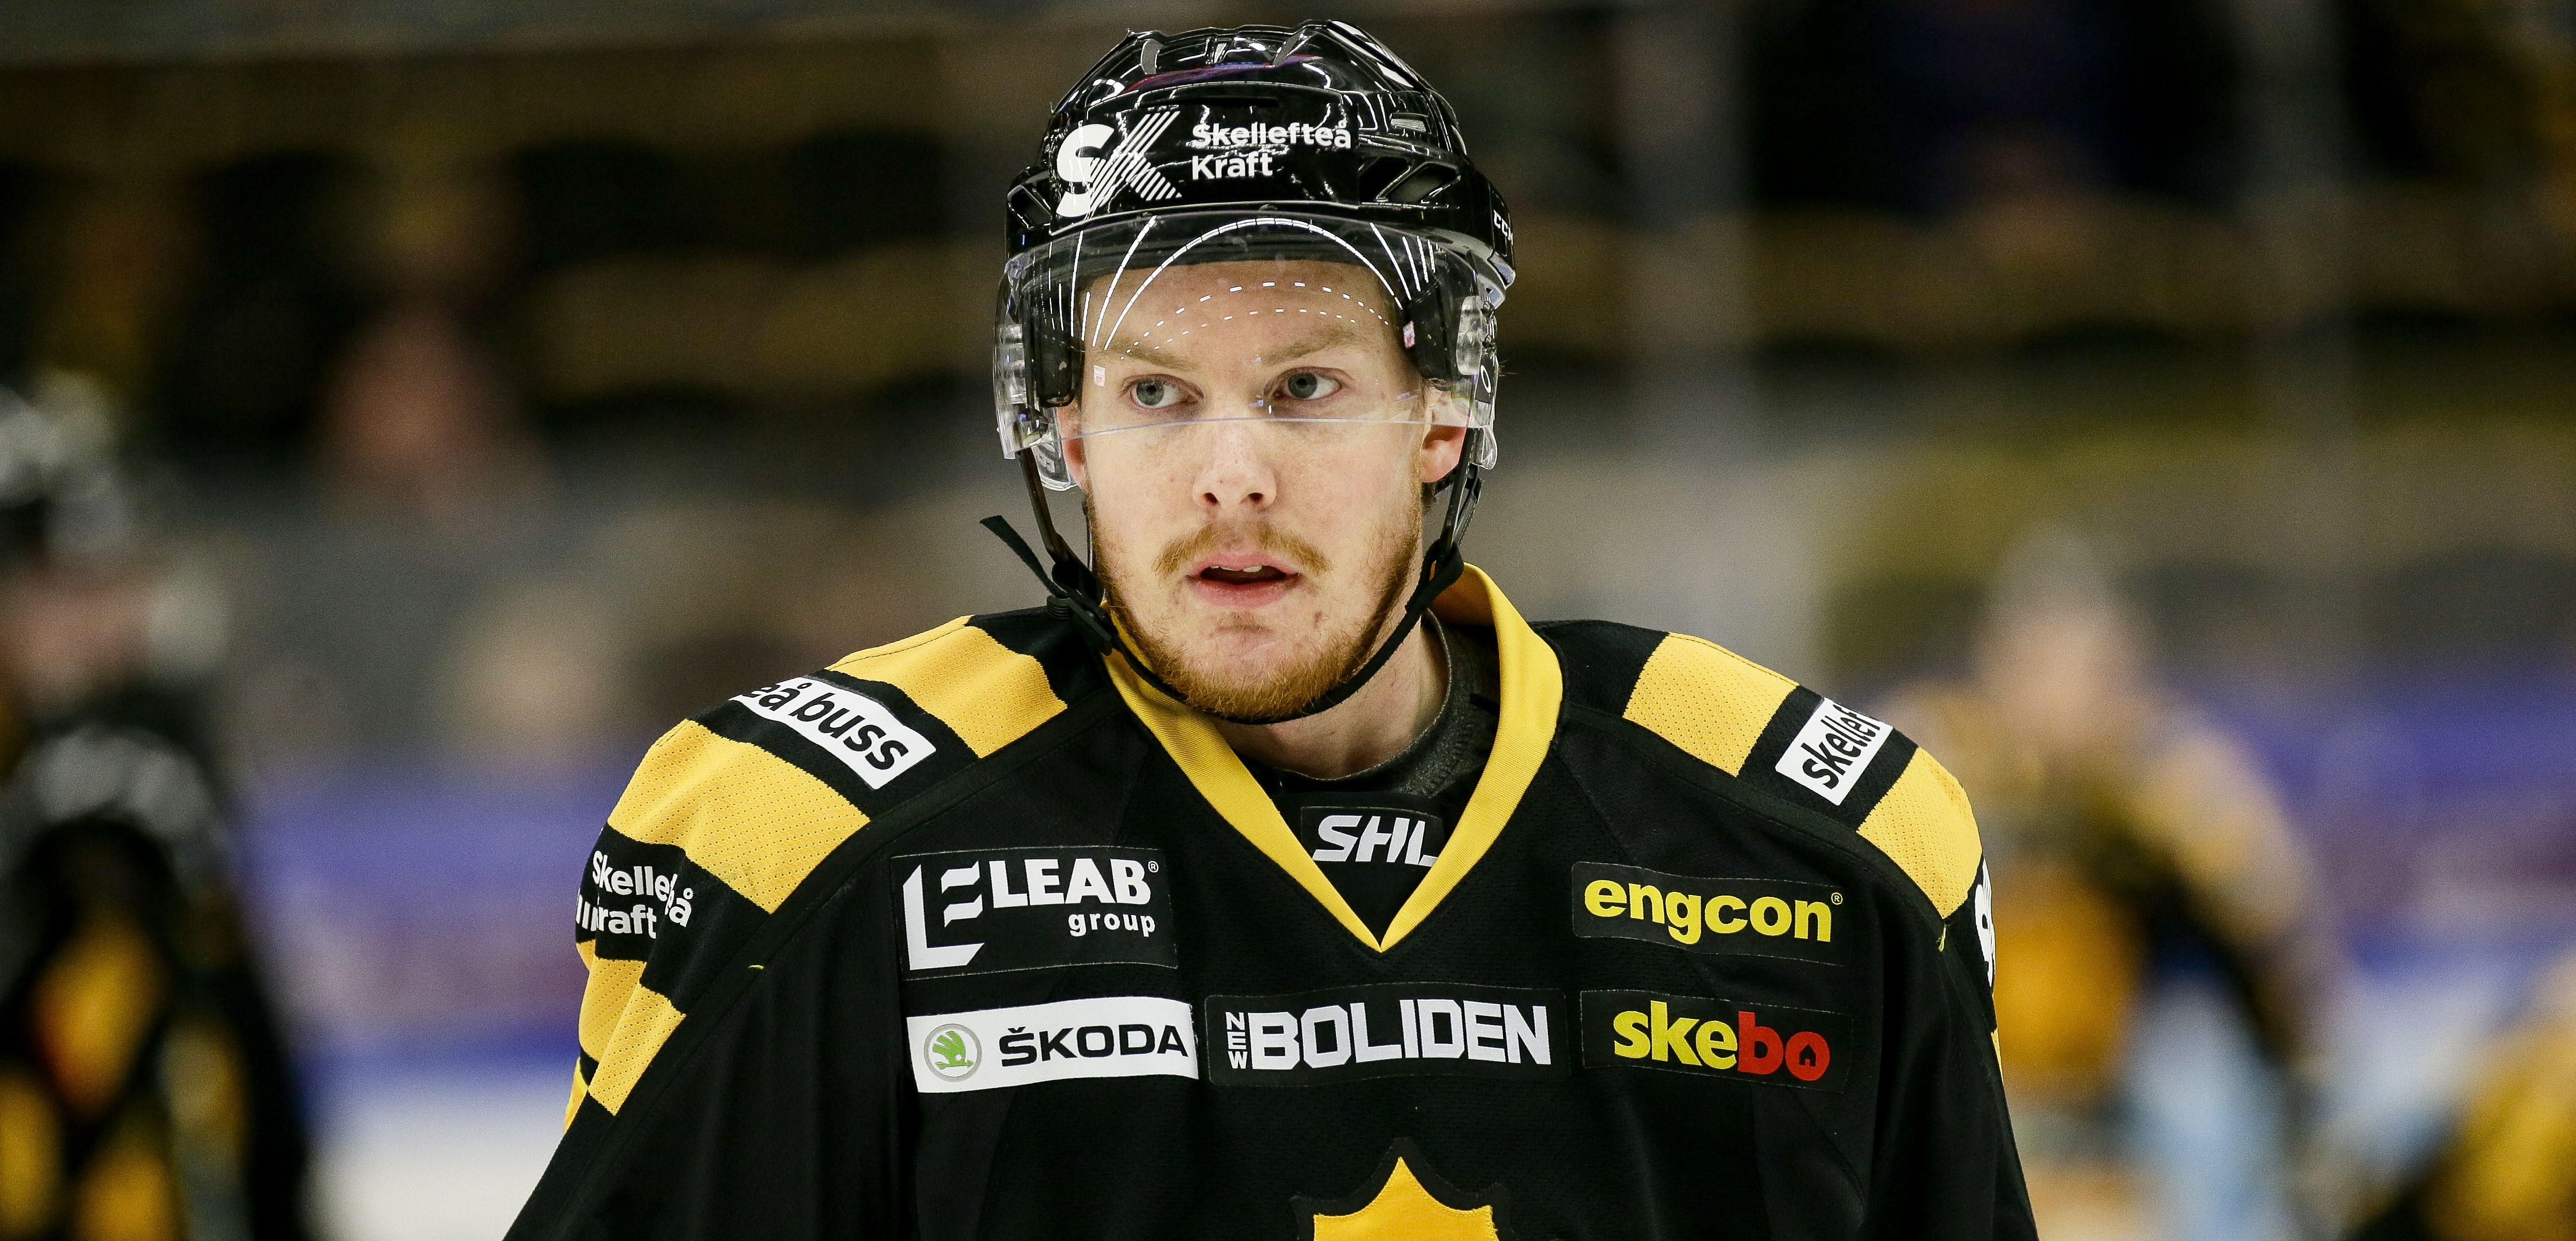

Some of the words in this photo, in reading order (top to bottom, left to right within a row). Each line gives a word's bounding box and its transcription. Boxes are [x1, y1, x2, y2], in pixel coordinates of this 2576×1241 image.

[1192, 120, 1351, 149] Skellefteå
[1192, 152, 1273, 180] Kraft
[788, 693, 909, 770] buss
[1312, 814, 1438, 867] SHL
[1067, 912, 1156, 937] group
[998, 1024, 1189, 1067] ŠKODA
[1226, 1011, 1247, 1069] NEW
[1248, 998, 1551, 1070] BOLIDEN
[1613, 1000, 1831, 1081] skebo
